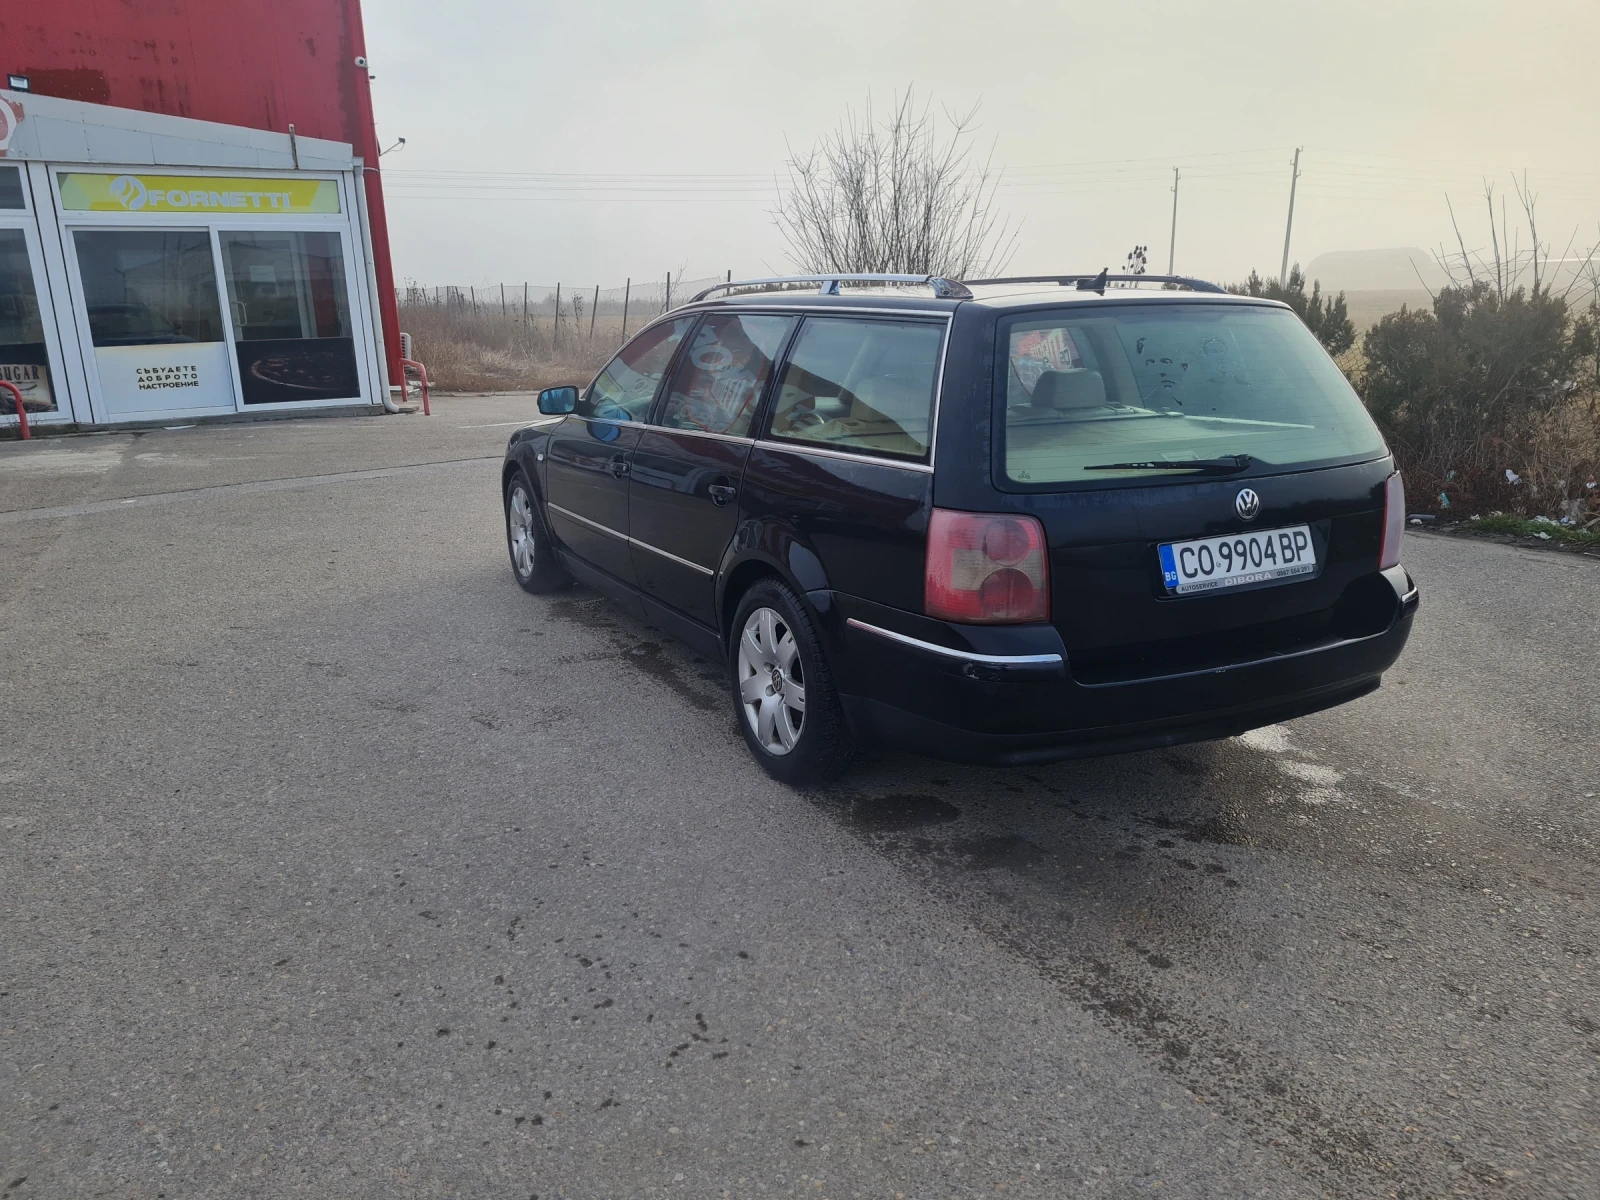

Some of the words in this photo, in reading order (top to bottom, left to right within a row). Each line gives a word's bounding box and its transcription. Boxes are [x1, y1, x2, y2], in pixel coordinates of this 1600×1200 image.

[148, 189, 290, 208] FORNETTI
[136, 365, 197, 375] СЪБУДЕТЕ
[138, 373, 198, 383] ДОБРОТО
[139, 380, 199, 390] НАСТРОЕНИЕ
[1218, 535, 1277, 573] 9904
[1278, 530, 1308, 564] BP
[1164, 571, 1177, 581] BG
[1181, 581, 1219, 592] AUTOSERVICE
[1224, 571, 1273, 586] DIBORA
